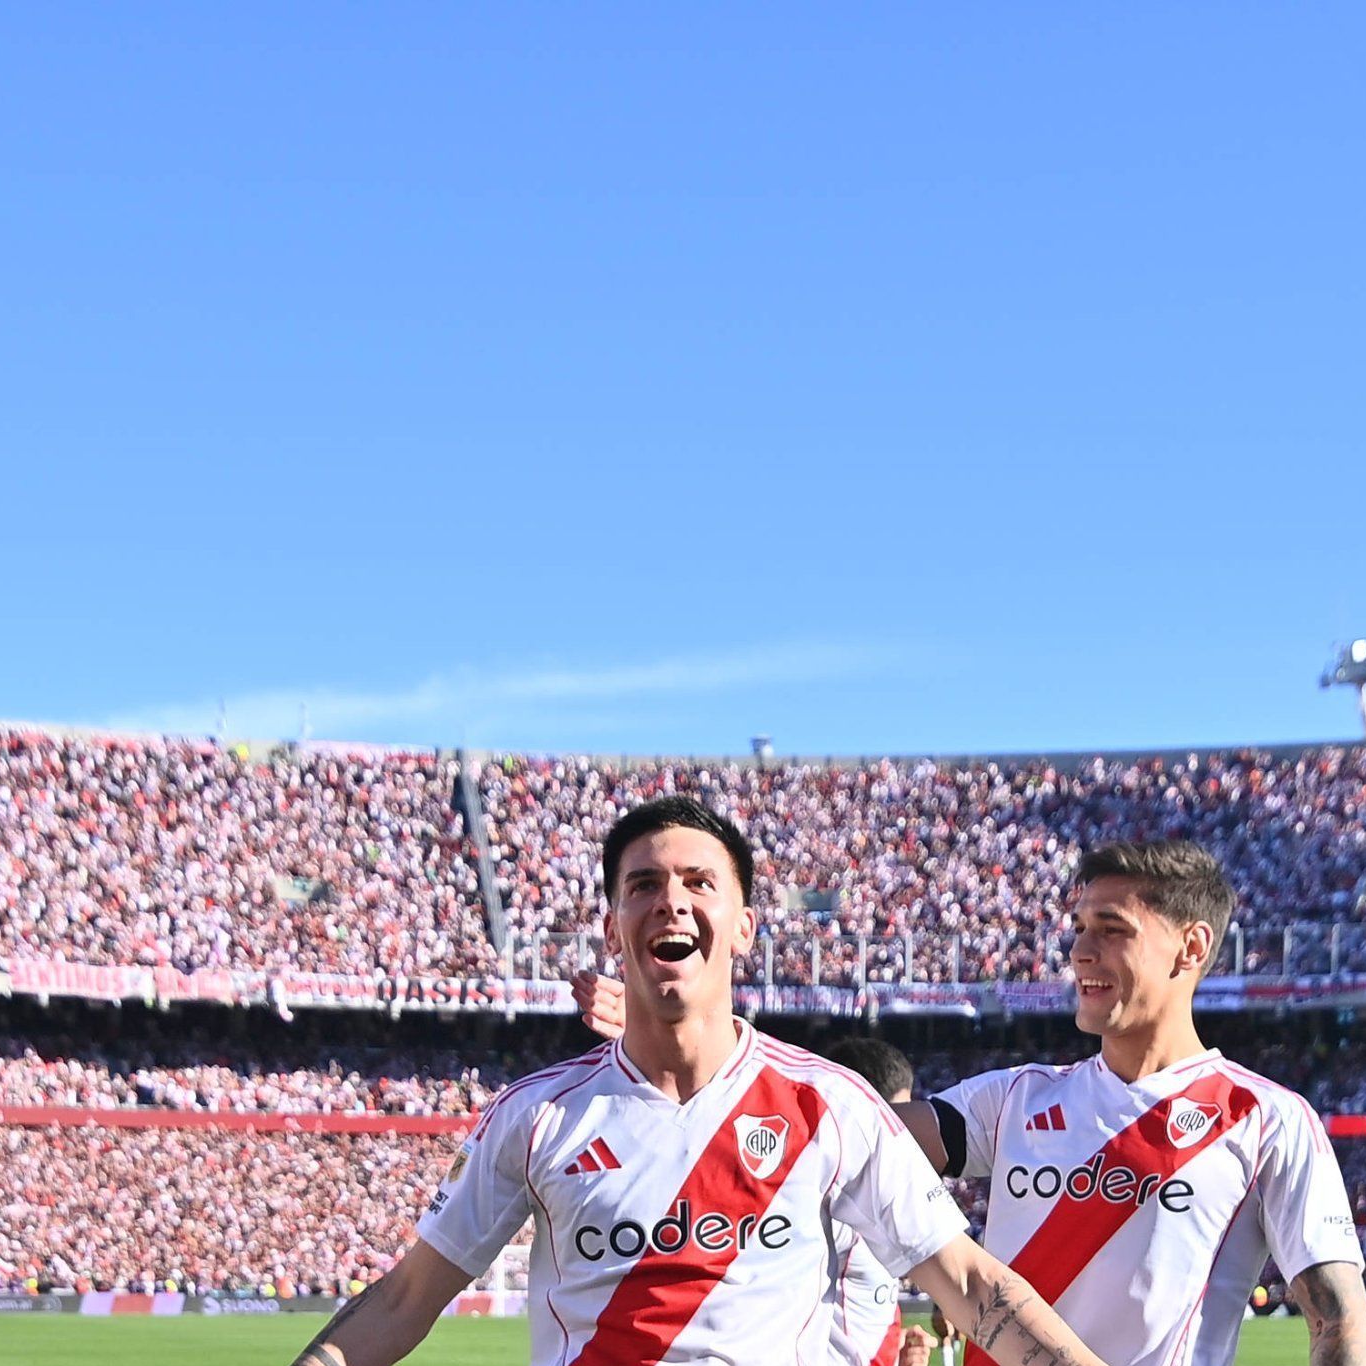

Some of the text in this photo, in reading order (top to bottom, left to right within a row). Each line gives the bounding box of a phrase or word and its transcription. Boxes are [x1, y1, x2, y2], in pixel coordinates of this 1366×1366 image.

[745, 1125, 777, 1157] CARP
[1006, 1153, 1194, 1213] codere
[575, 1198, 791, 1261] codere
